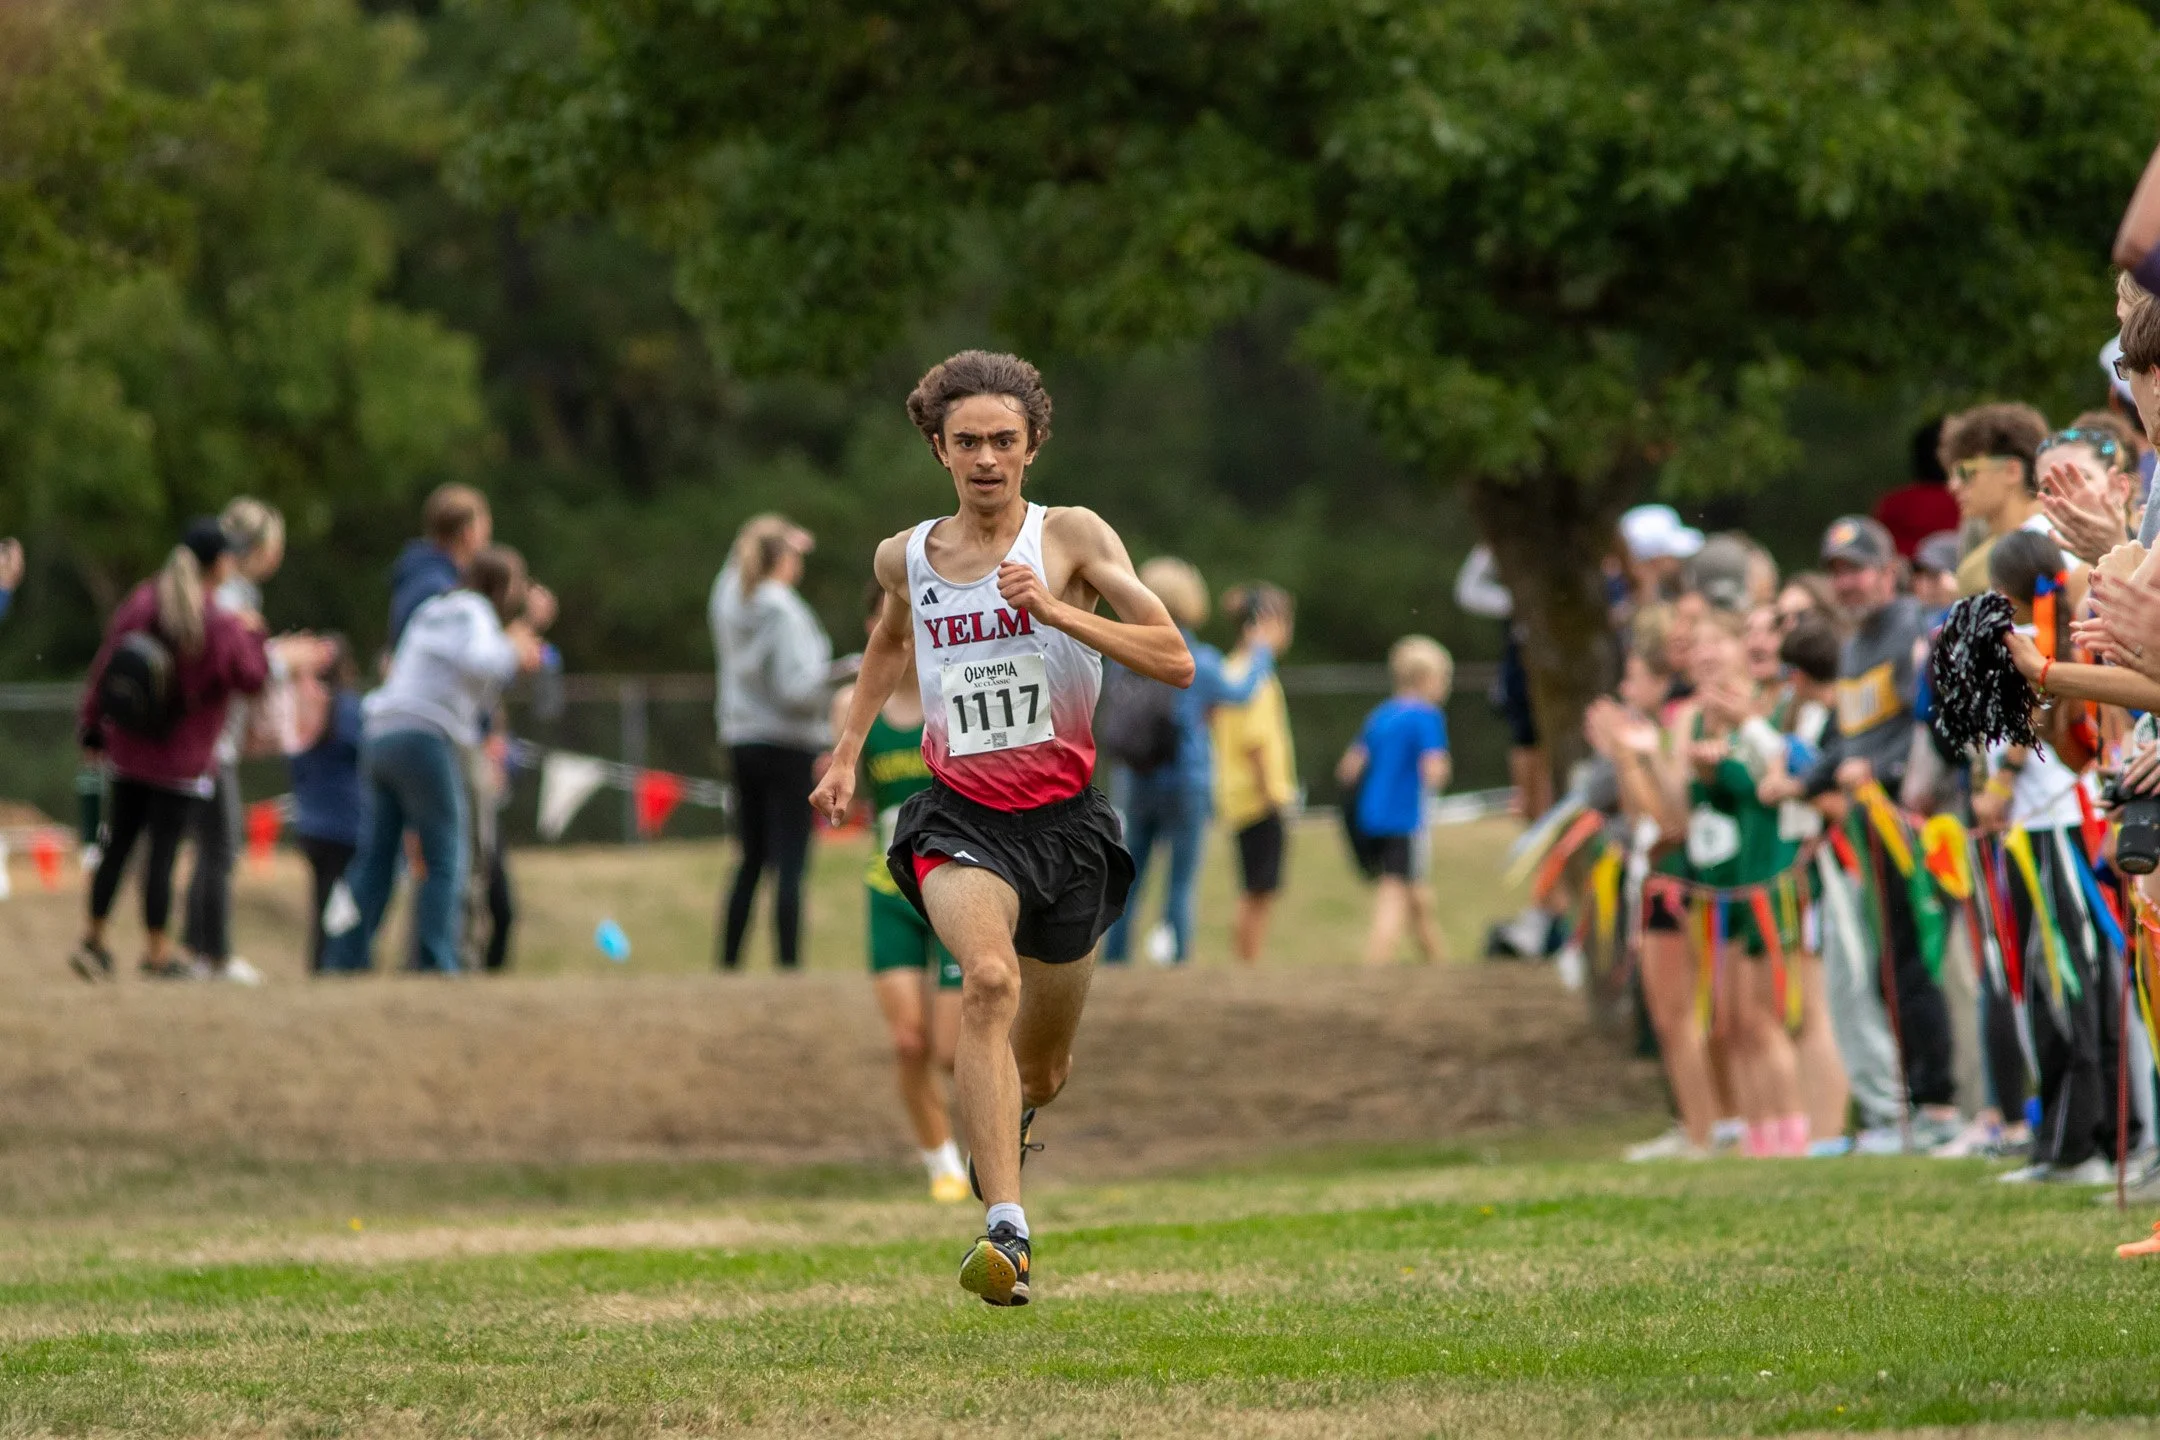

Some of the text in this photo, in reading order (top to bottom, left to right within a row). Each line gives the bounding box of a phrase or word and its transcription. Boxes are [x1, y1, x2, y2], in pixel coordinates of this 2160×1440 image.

[924, 606, 1035, 648] YELM
[964, 660, 1018, 683] OLYMPIA
[983, 679, 1011, 688] CLASSIC
[952, 684, 1040, 733] 1117
